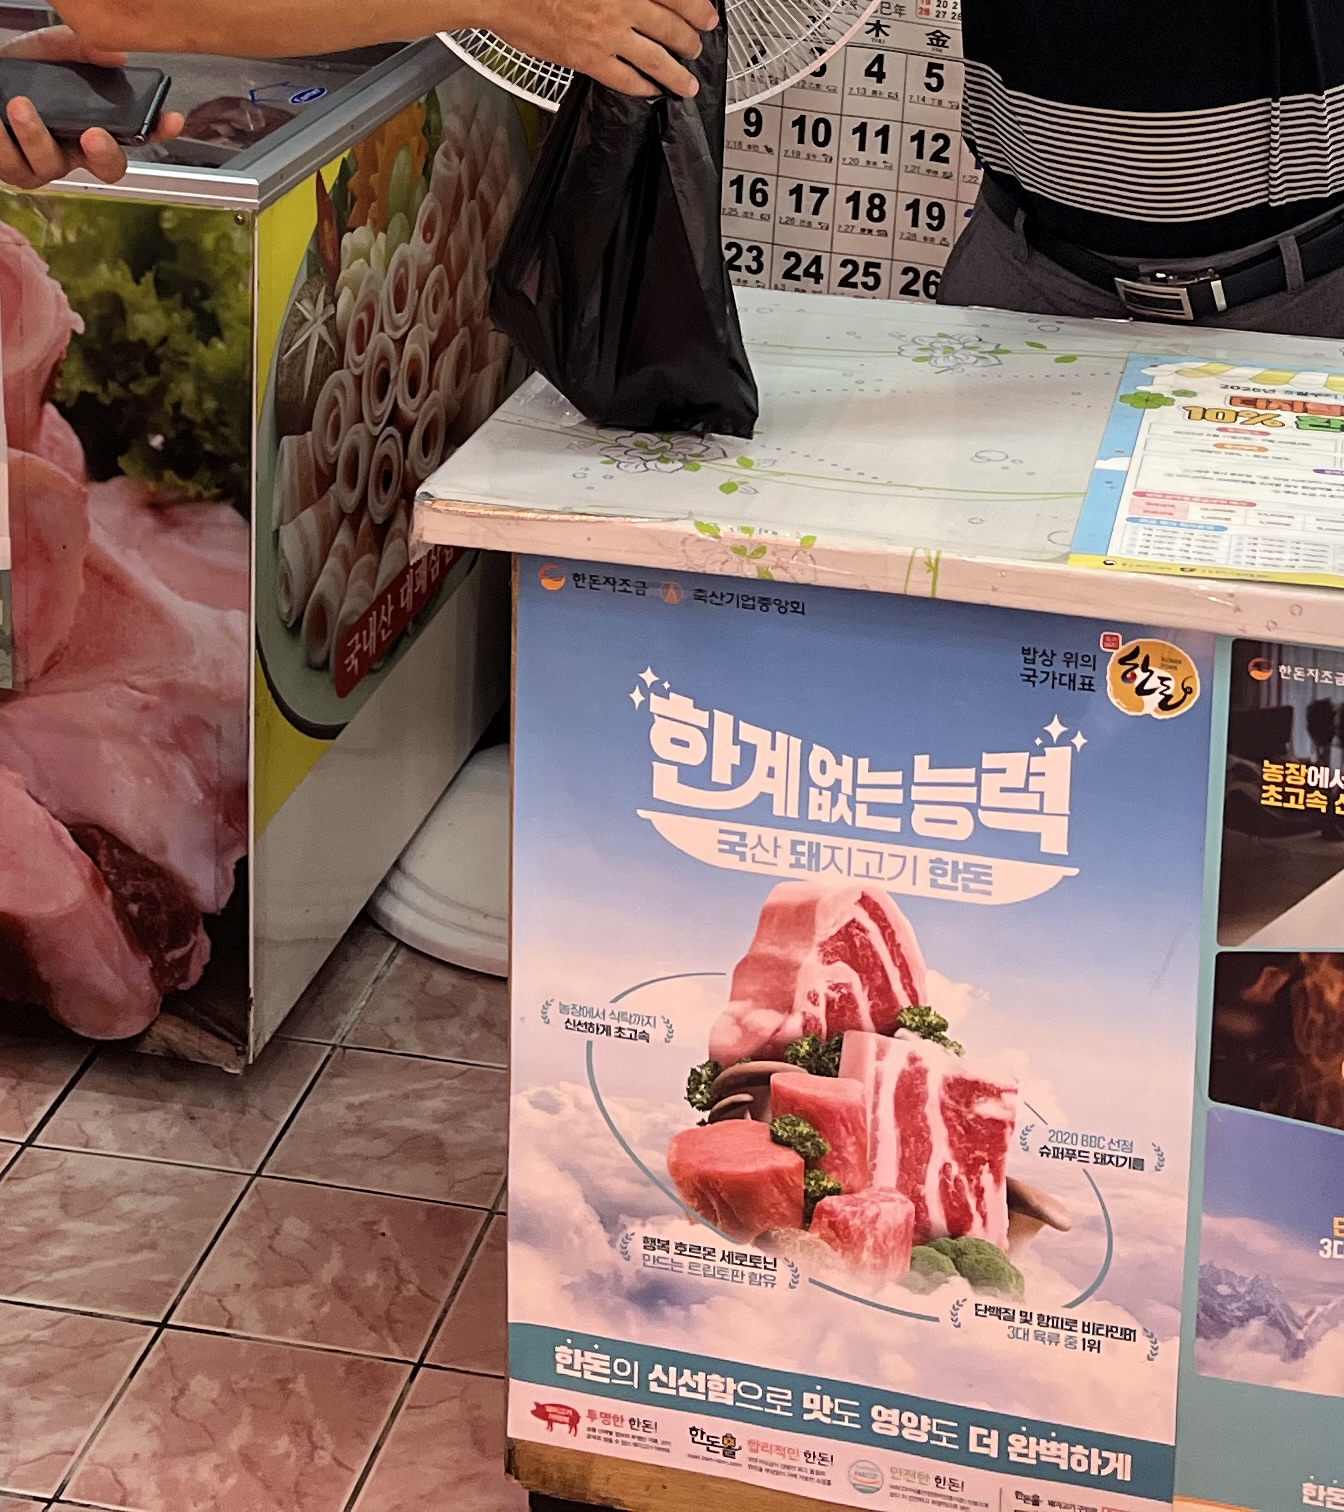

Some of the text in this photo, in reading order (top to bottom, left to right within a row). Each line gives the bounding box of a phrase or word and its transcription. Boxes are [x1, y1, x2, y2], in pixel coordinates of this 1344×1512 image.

[864, 19, 952, 50] 木 金
[864, 53, 946, 93] 4 5
[742, 106, 763, 139] 9
[790, 113, 833, 148] 10
[850, 121, 891, 155] 11
[909, 128, 951, 165] 12
[728, 173, 946, 232] 16 17 18 19
[723, 240, 941, 301] 23 24 25 26
[1182, 405, 1286, 428] 10%
[570, 569, 807, 616] 한돈자조금 축산기업중앙회
[1019, 644, 1098, 672] 밥상 위의
[1018, 667, 1097, 694] 국가대표
[1259, 782, 1329, 816] 초고속
[716, 827, 994, 897] 국산 돼지고기 한돈
[563, 1016, 651, 1044] 신선하게 초고속
[1037, 1143, 1146, 1171] 슈퍼푸드 돼지기름
[1047, 1129, 1134, 1154] 2020 BBC 선정
[641, 1234, 778, 1272] 행복 호르몬 세로토닌
[641, 1252, 778, 1290] 만드는 트립토판 함유
[973, 1302, 1016, 1324] 단백질
[1017, 1308, 1033, 1328] 및
[1006, 1324, 1102, 1355] 3대 육류 중 1위
[554, 1343, 1133, 1482] 한돈의 신선함으로 맛도 영양도 더 완벽하게
[585, 1408, 659, 1434] 투명한 한돈!
[747, 1438, 835, 1467] 합리적인 한돈!
[933, 1474, 966, 1493] 한돈!
